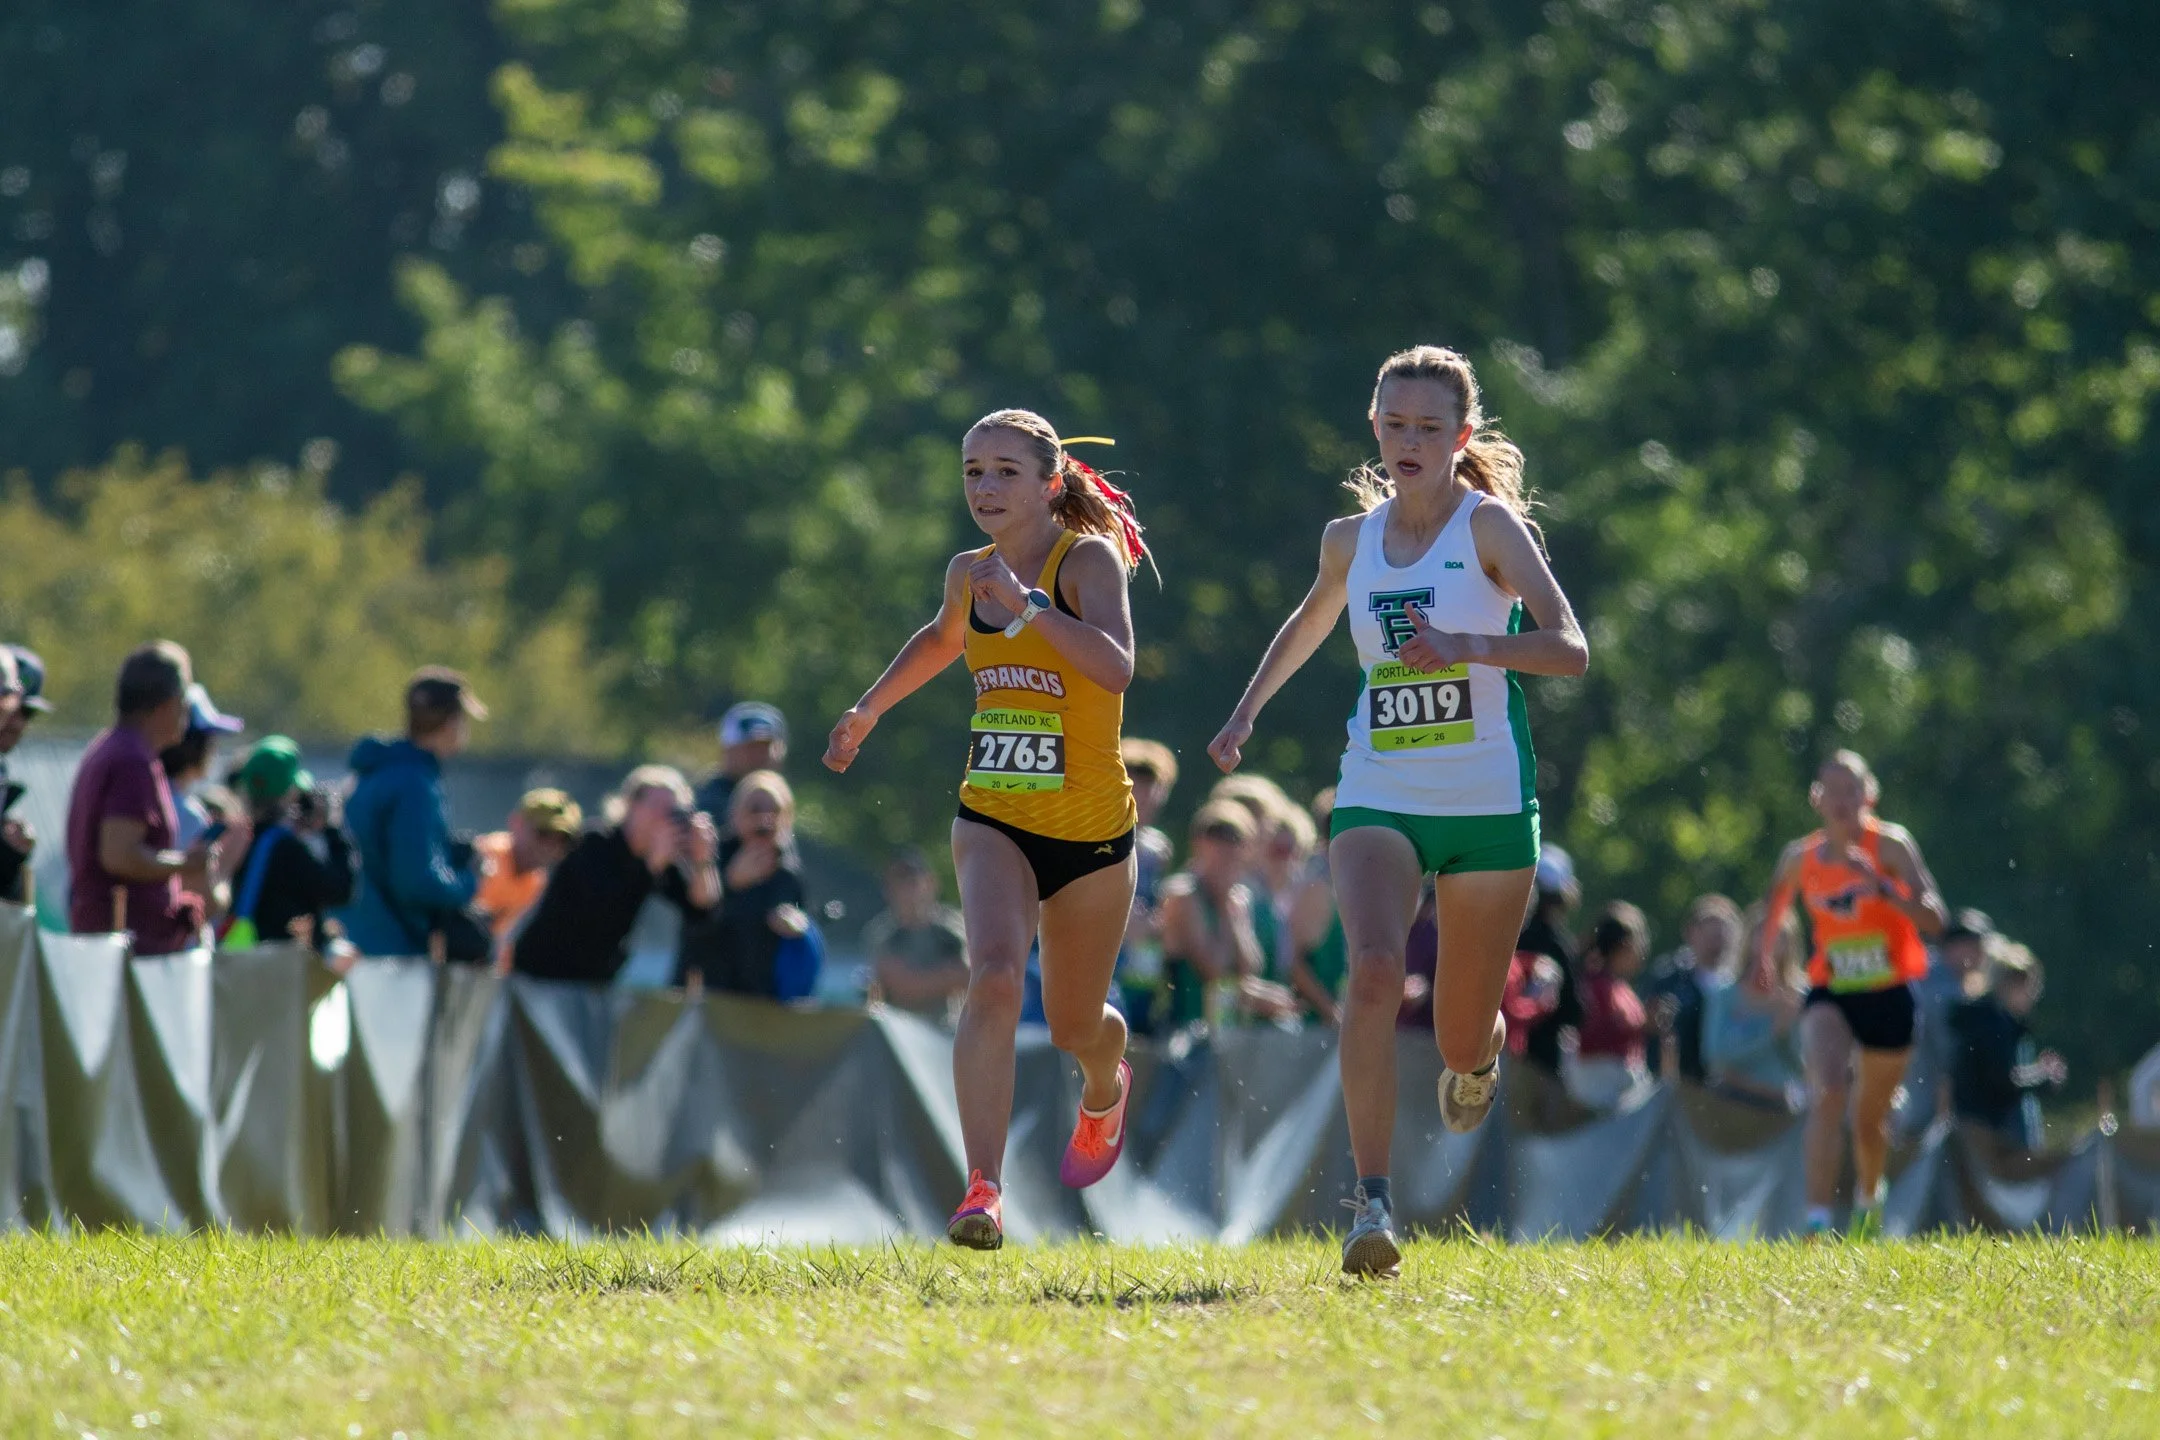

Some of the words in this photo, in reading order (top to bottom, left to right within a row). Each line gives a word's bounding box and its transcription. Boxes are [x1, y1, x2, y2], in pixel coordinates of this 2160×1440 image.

[977, 665, 1064, 697] FRANCIS
[1377, 684, 1460, 725] 3019
[980, 712, 1036, 726] PORTLAND
[1040, 717, 1053, 727] XC
[1395, 736, 1405, 744] 20
[1434, 732, 1445, 741] 26
[978, 734, 1057, 771] 2765
[991, 780, 1001, 789] 20
[1026, 782, 1037, 790] 26
